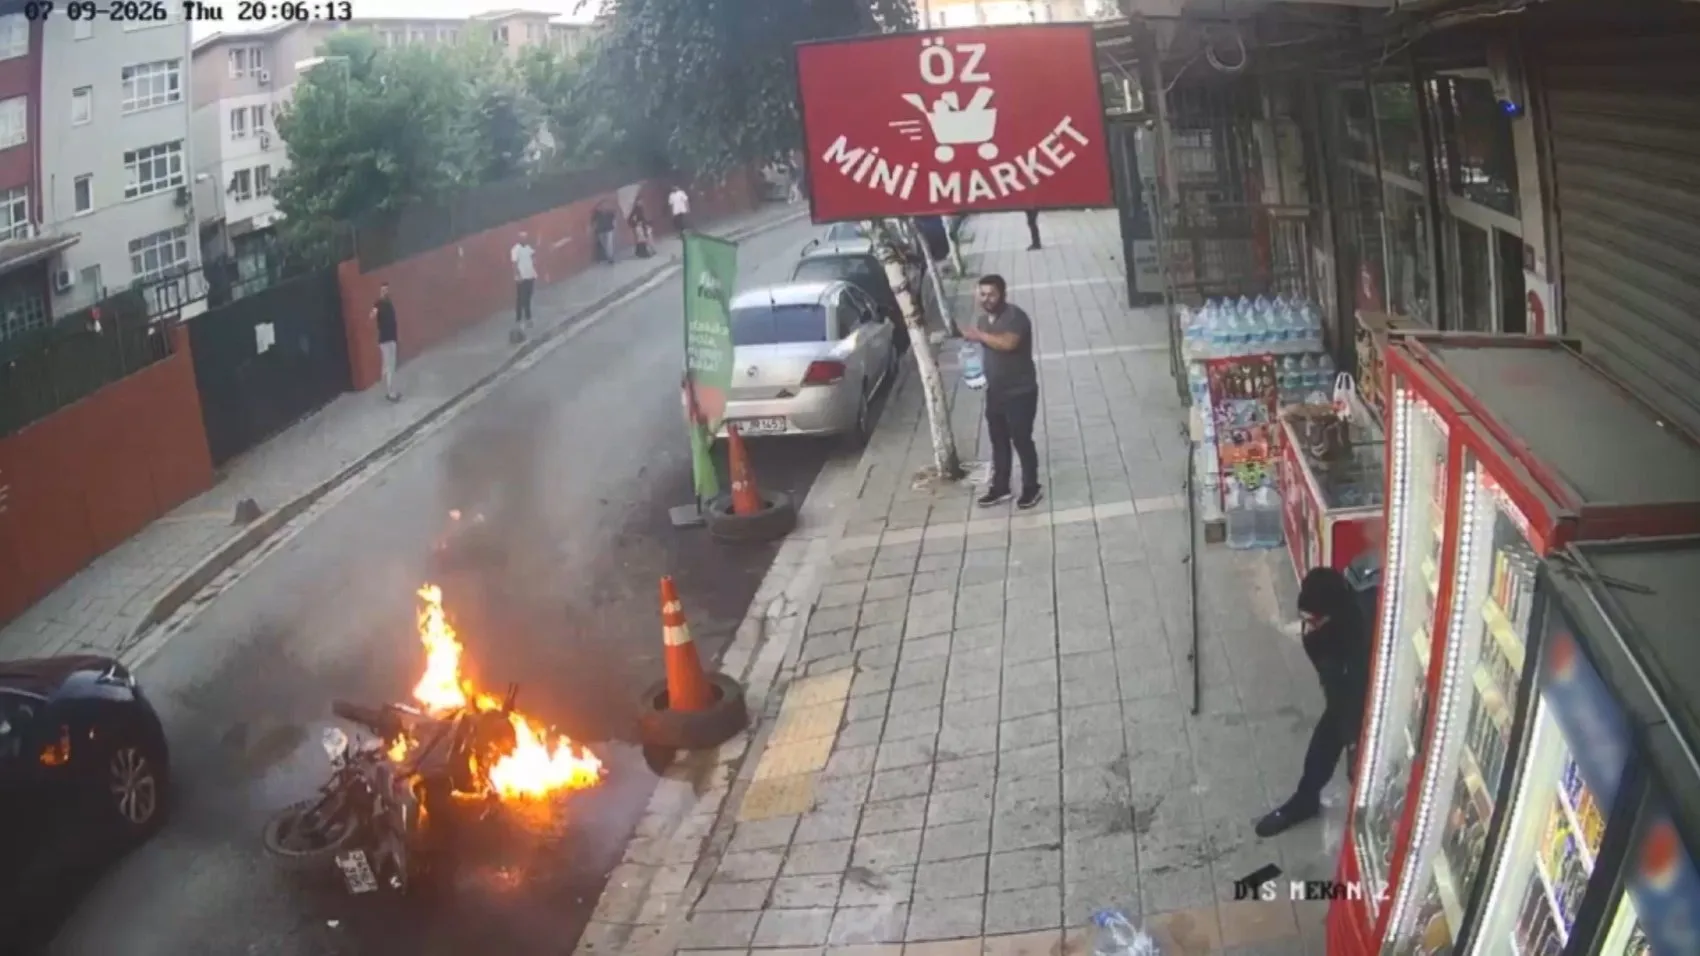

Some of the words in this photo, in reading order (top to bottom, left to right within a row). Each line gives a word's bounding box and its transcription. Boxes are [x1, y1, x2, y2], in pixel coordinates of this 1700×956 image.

[919, 37, 991, 85] ÖZ
[822, 134, 919, 200] MİNİ
[928, 115, 1089, 204] MARKET
